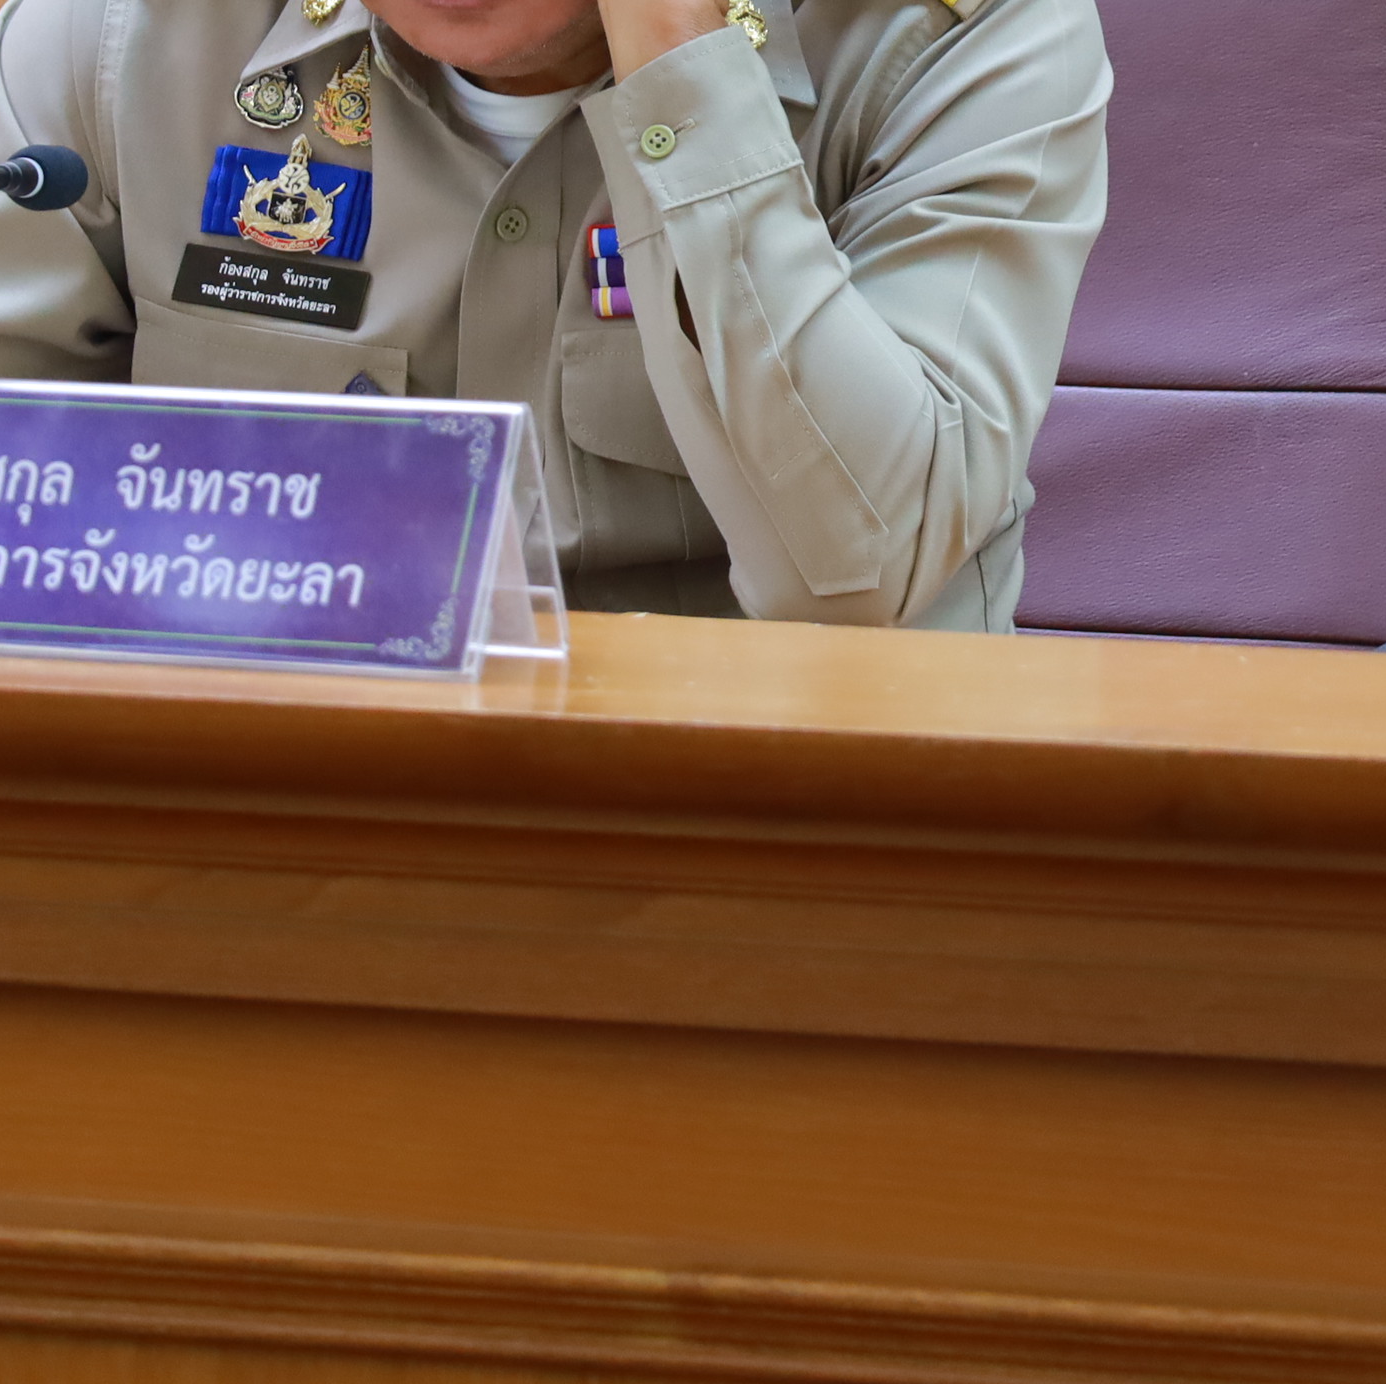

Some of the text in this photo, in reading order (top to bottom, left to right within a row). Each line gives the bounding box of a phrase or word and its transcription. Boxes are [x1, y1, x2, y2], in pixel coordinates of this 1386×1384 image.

[219, 256, 331, 290] ก้องสกุล จันทราช
[201, 282, 337, 314] รองผู้ว่าราชการจังหวัดยะลา
[116, 442, 321, 519] จันทราช
